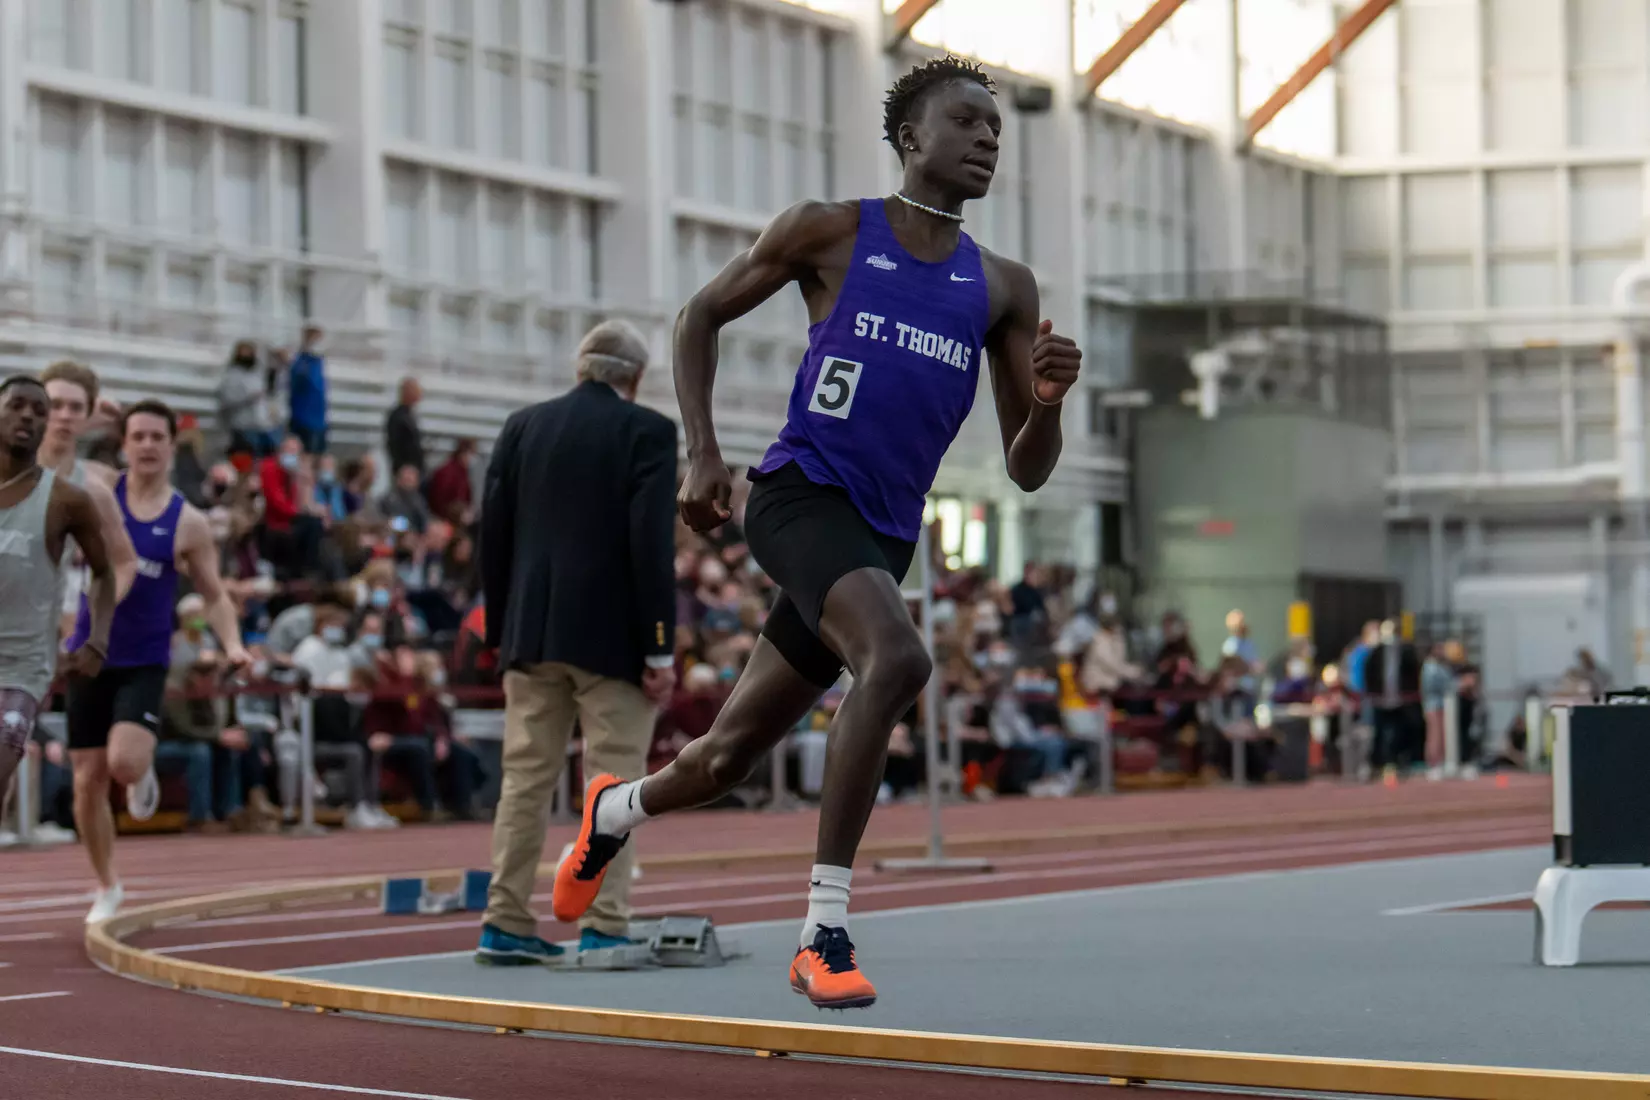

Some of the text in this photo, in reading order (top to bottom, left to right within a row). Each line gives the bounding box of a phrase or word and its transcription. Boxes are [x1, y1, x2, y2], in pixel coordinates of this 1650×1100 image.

[854, 312, 972, 372] ST. THOMAS
[817, 359, 856, 410] 5
